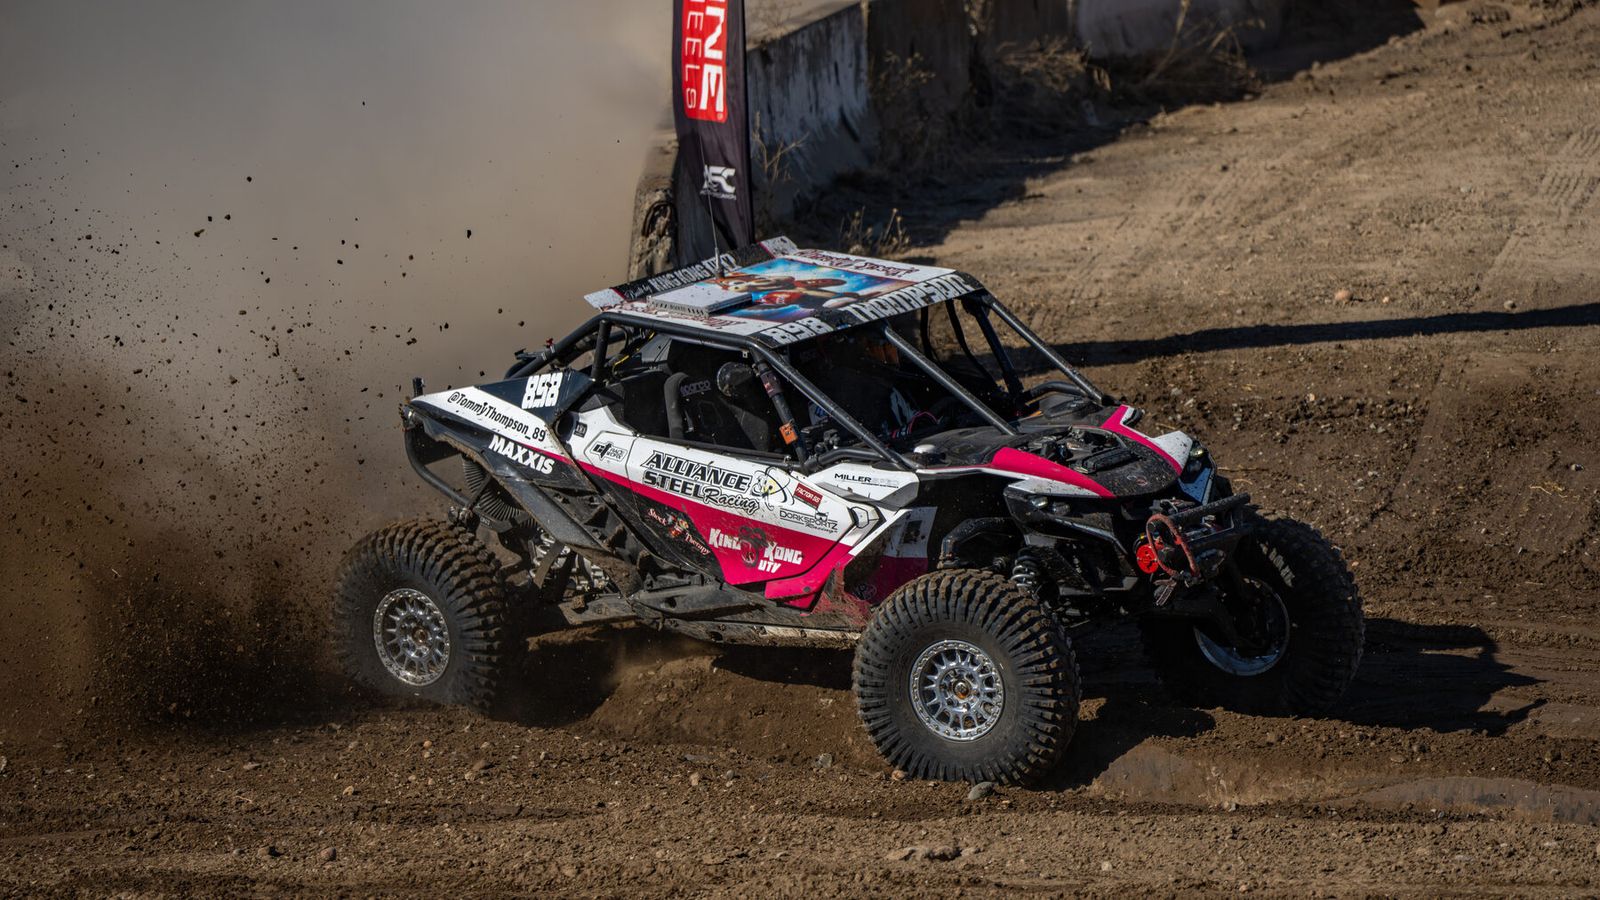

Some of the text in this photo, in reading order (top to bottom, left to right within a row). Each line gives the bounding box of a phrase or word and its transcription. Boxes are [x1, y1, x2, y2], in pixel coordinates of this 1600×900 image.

[685, 0, 704, 109] EELS
[699, 0, 726, 112] NE
[648, 271, 681, 292] KING
[674, 264, 711, 284] KONG
[840, 273, 976, 323] THOMPSON
[447, 391, 547, 442] @TommyThompson_89
[488, 434, 556, 475] MAXXIS
[642, 451, 752, 493] ALLIANCE
[643, 470, 760, 515] STEEL Racing
[796, 487, 813, 499] FACTOR
[834, 473, 872, 483] MILLER
[647, 508, 711, 555] Shock Therapy
[779, 510, 838, 530] DORKSPORTZ
[708, 527, 803, 565] KING KONG
[757, 559, 781, 574] UTV
